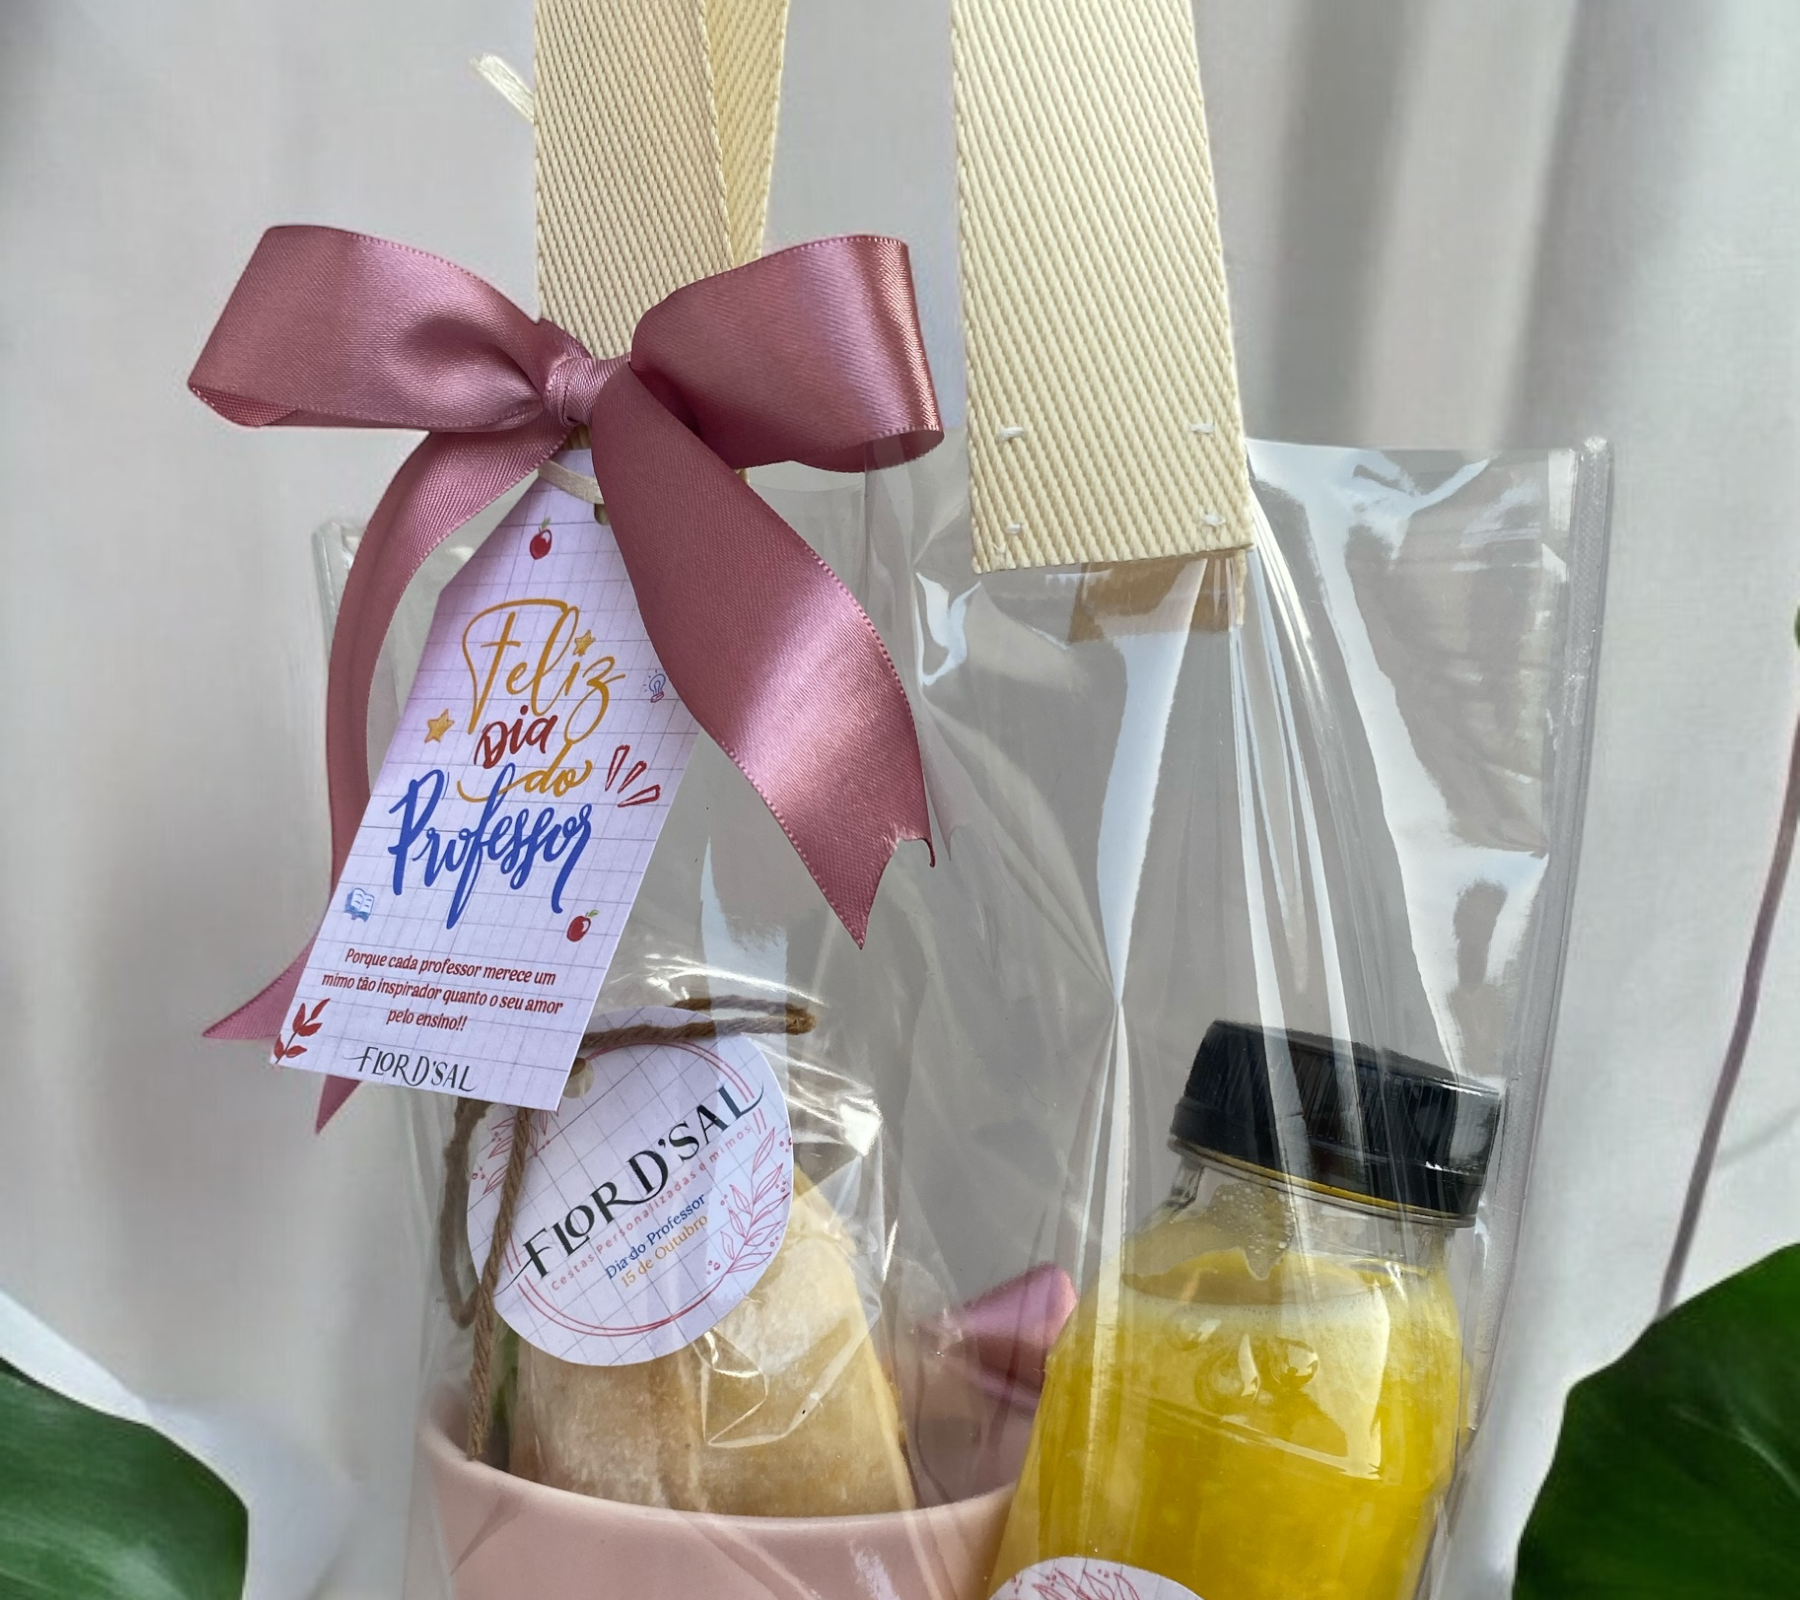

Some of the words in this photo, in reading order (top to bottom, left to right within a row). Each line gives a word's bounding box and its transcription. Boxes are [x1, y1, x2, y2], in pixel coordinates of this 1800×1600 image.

[462, 598, 627, 745] Feliz
[474, 705, 558, 769] Dia
[457, 743, 593, 802] do
[388, 763, 592, 929] Professor
[321, 973, 355, 989] mimo
[356, 976, 376, 991] tão
[376, 977, 442, 1000] inspirador
[443, 989, 487, 1006] quanto
[489, 995, 498, 1007] o
[499, 996, 524, 1010] seu
[524, 999, 564, 1014] amor
[345, 948, 387, 969] Porque
[388, 954, 418, 970] cada
[418, 958, 482, 978] professor
[482, 966, 532, 983] merece
[534, 971, 556, 986] um
[386, 1008, 414, 1025] pelo
[416, 1013, 468, 1031] ensino!!
[342, 1046, 415, 1086] FLOR
[411, 1055, 478, 1092] D'SAL
[494, 1180, 640, 1296] FLOR
[626, 1084, 764, 1199] D'SAL
[551, 1253, 595, 1291] Cestas
[596, 1171, 697, 1254] Personalizadas
[699, 1163, 706, 1171] e
[709, 1125, 751, 1163] mimos
[605, 1257, 629, 1279] Dia
[629, 1244, 646, 1260] do
[646, 1194, 706, 1246] Professor
[621, 1270, 636, 1288] 15
[638, 1259, 654, 1275] de
[654, 1216, 707, 1259] Outubro
